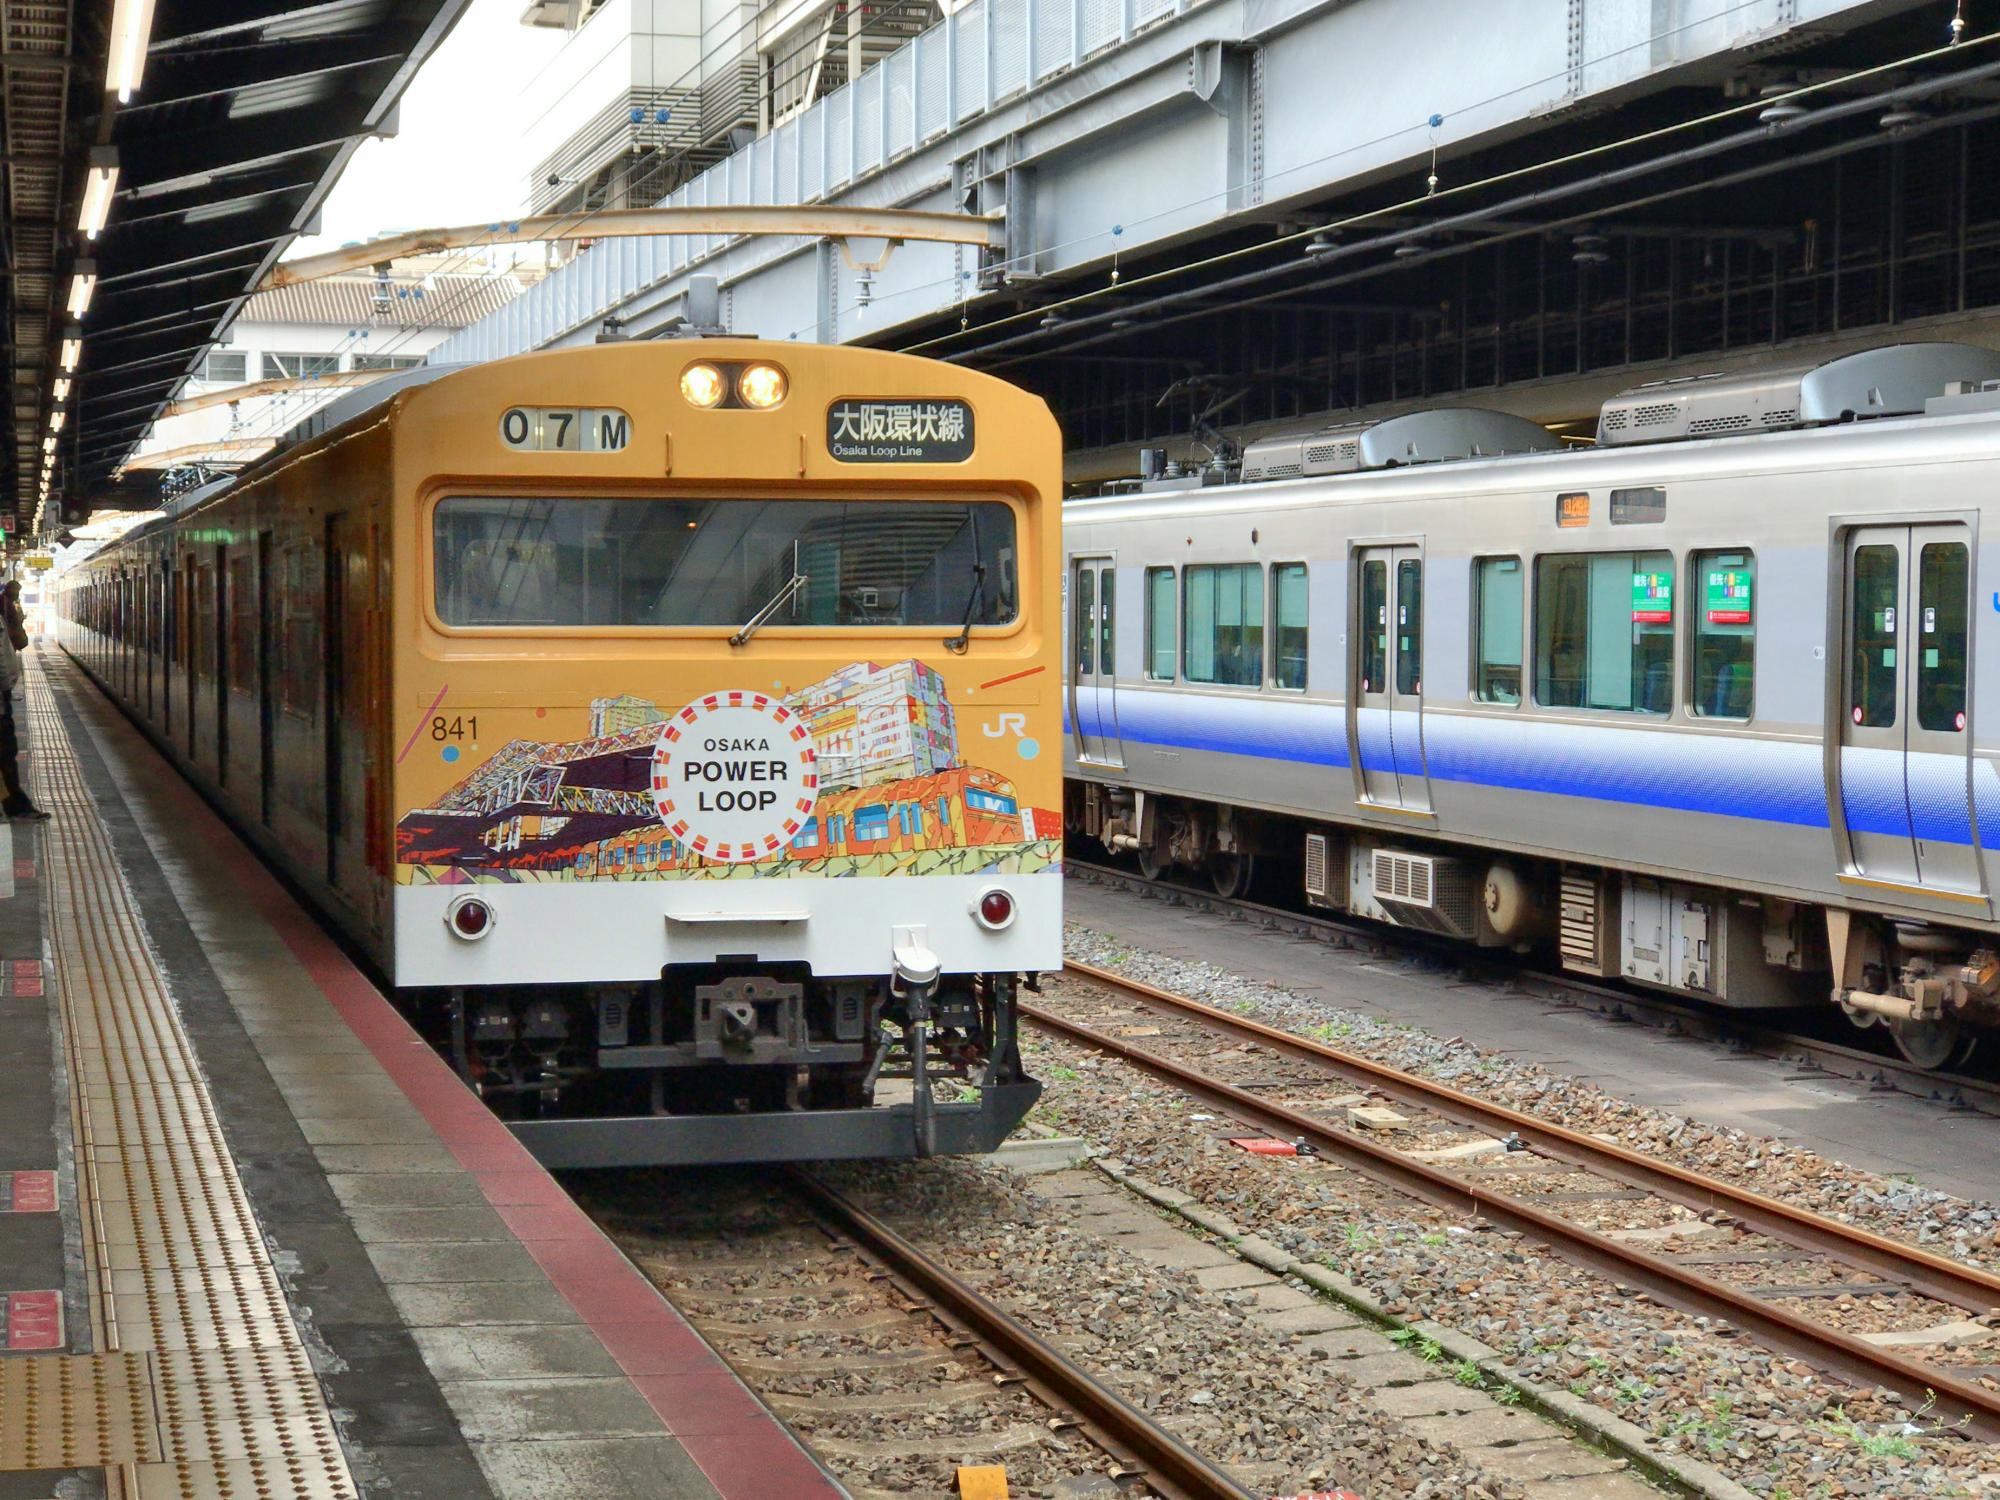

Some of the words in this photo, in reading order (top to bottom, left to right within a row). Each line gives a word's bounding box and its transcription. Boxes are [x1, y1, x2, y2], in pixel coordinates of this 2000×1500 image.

[833, 403, 965, 442] 大阪環状線
[870, 445, 897, 457] Loop
[900, 445, 923, 456] Line
[431, 715, 477, 741] 841
[982, 712, 1026, 738] JR
[703, 738, 770, 752] OSAKA
[683, 760, 788, 782] POWER
[698, 790, 777, 812] LOOP
